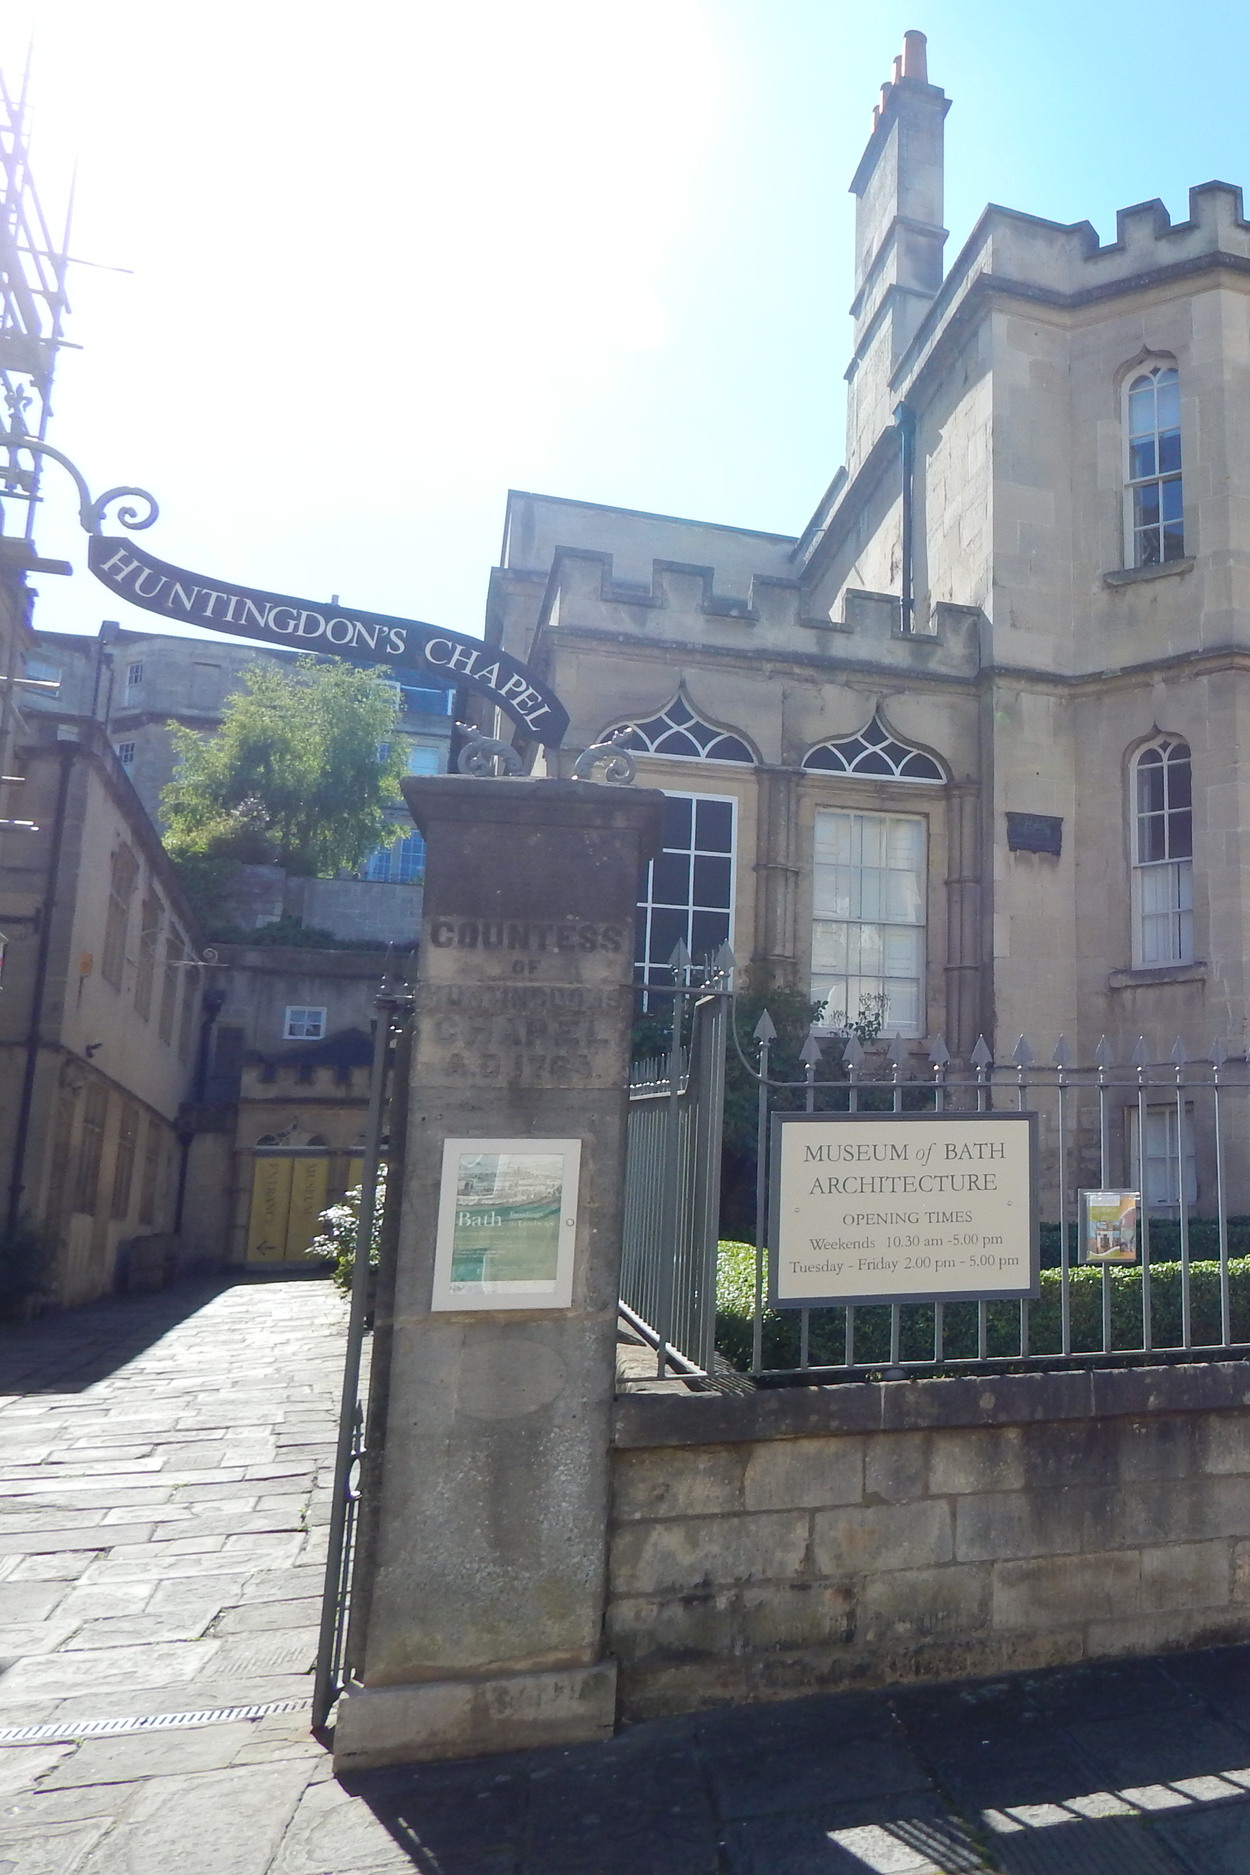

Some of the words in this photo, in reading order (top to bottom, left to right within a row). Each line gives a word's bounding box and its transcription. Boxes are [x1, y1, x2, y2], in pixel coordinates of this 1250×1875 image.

[100, 547, 407, 655] HUNTINGDON'S
[424, 637, 551, 732] CHAPEL
[430, 919, 623, 953] COUNTESS
[511, 959, 541, 975] OF
[803, 1144, 909, 1162] MUSEUM
[915, 1142, 937, 1167] of
[944, 1142, 1006, 1160] BATH
[809, 1173, 998, 1195] ARCHITECTURE
[457, 1211, 503, 1227] Bath
[842, 1212, 919, 1226] OPENING
[924, 1210, 973, 1224] TIMES
[809, 1237, 876, 1251] Weekends
[886, 1235, 920, 1248] 10.30
[923, 1236, 943, 1247] am
[982, 1234, 1003, 1249] pm
[789, 1259, 844, 1276] Tuesday
[858, 1256, 899, 1273] Friday
[904, 1256, 932, 1270] 2.00
[935, 1258, 956, 1273] pm
[969, 1254, 996, 1267] 5.00
[999, 1256, 1020, 1270] pm
